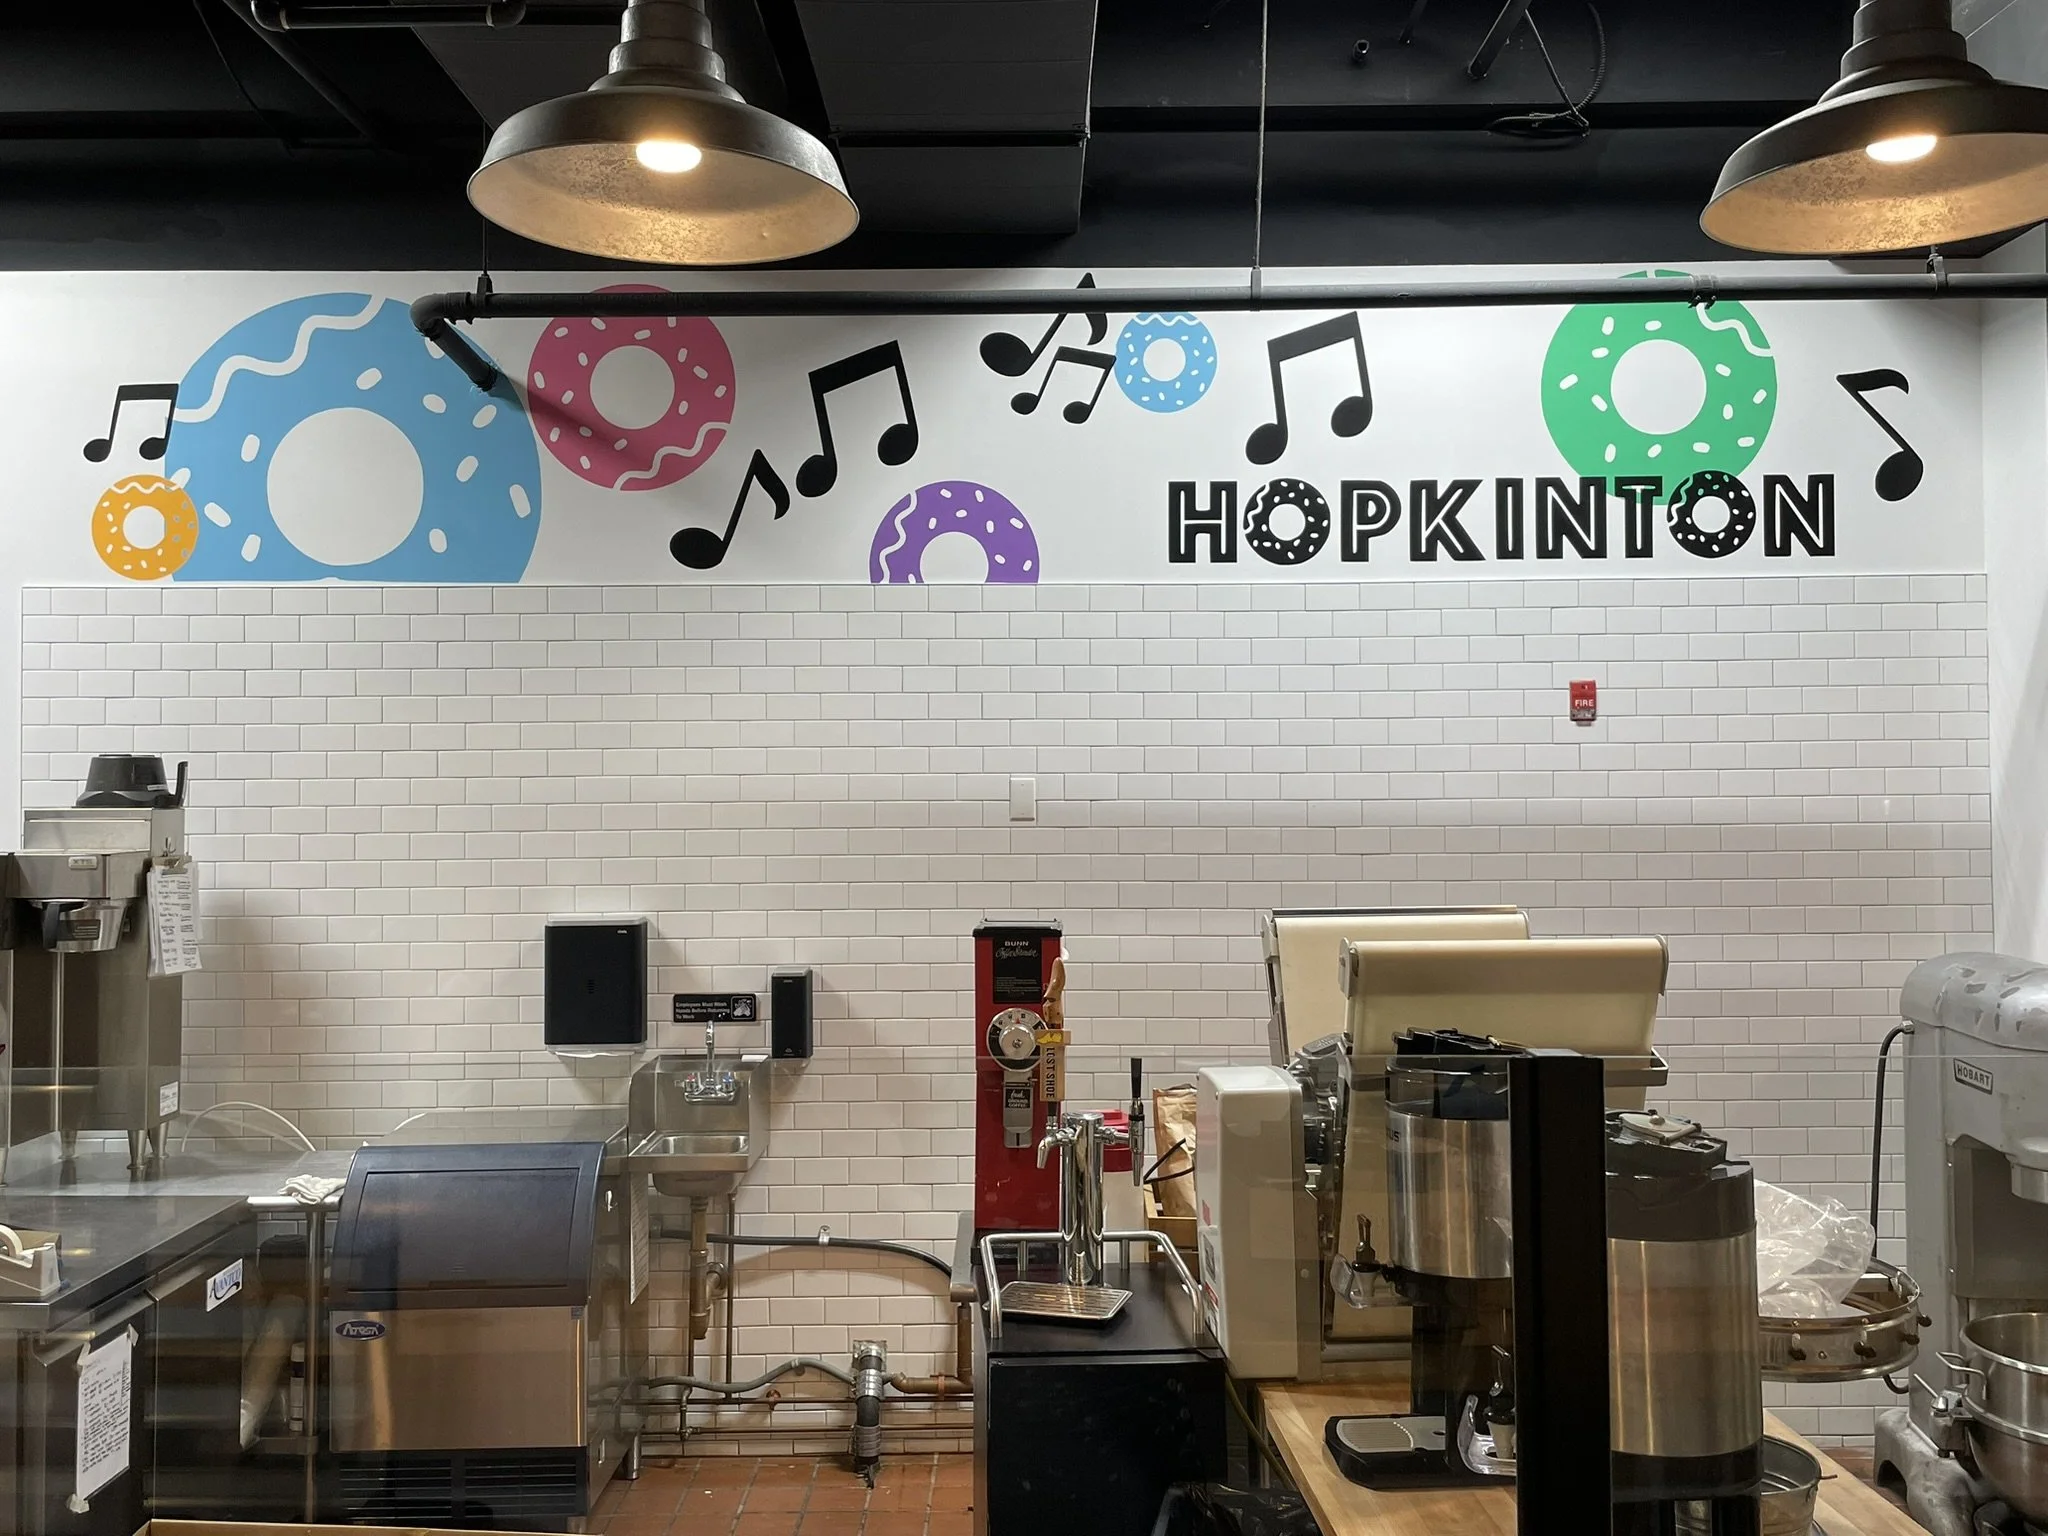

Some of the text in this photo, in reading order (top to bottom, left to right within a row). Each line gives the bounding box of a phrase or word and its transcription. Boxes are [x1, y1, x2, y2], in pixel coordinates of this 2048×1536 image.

[1168, 469, 1836, 565] HOPKINTON
[1574, 699, 1594, 707] FIRE
[1046, 1047, 1056, 1098] LOST SHOE
[1957, 1063, 1990, 1088] HOBART
